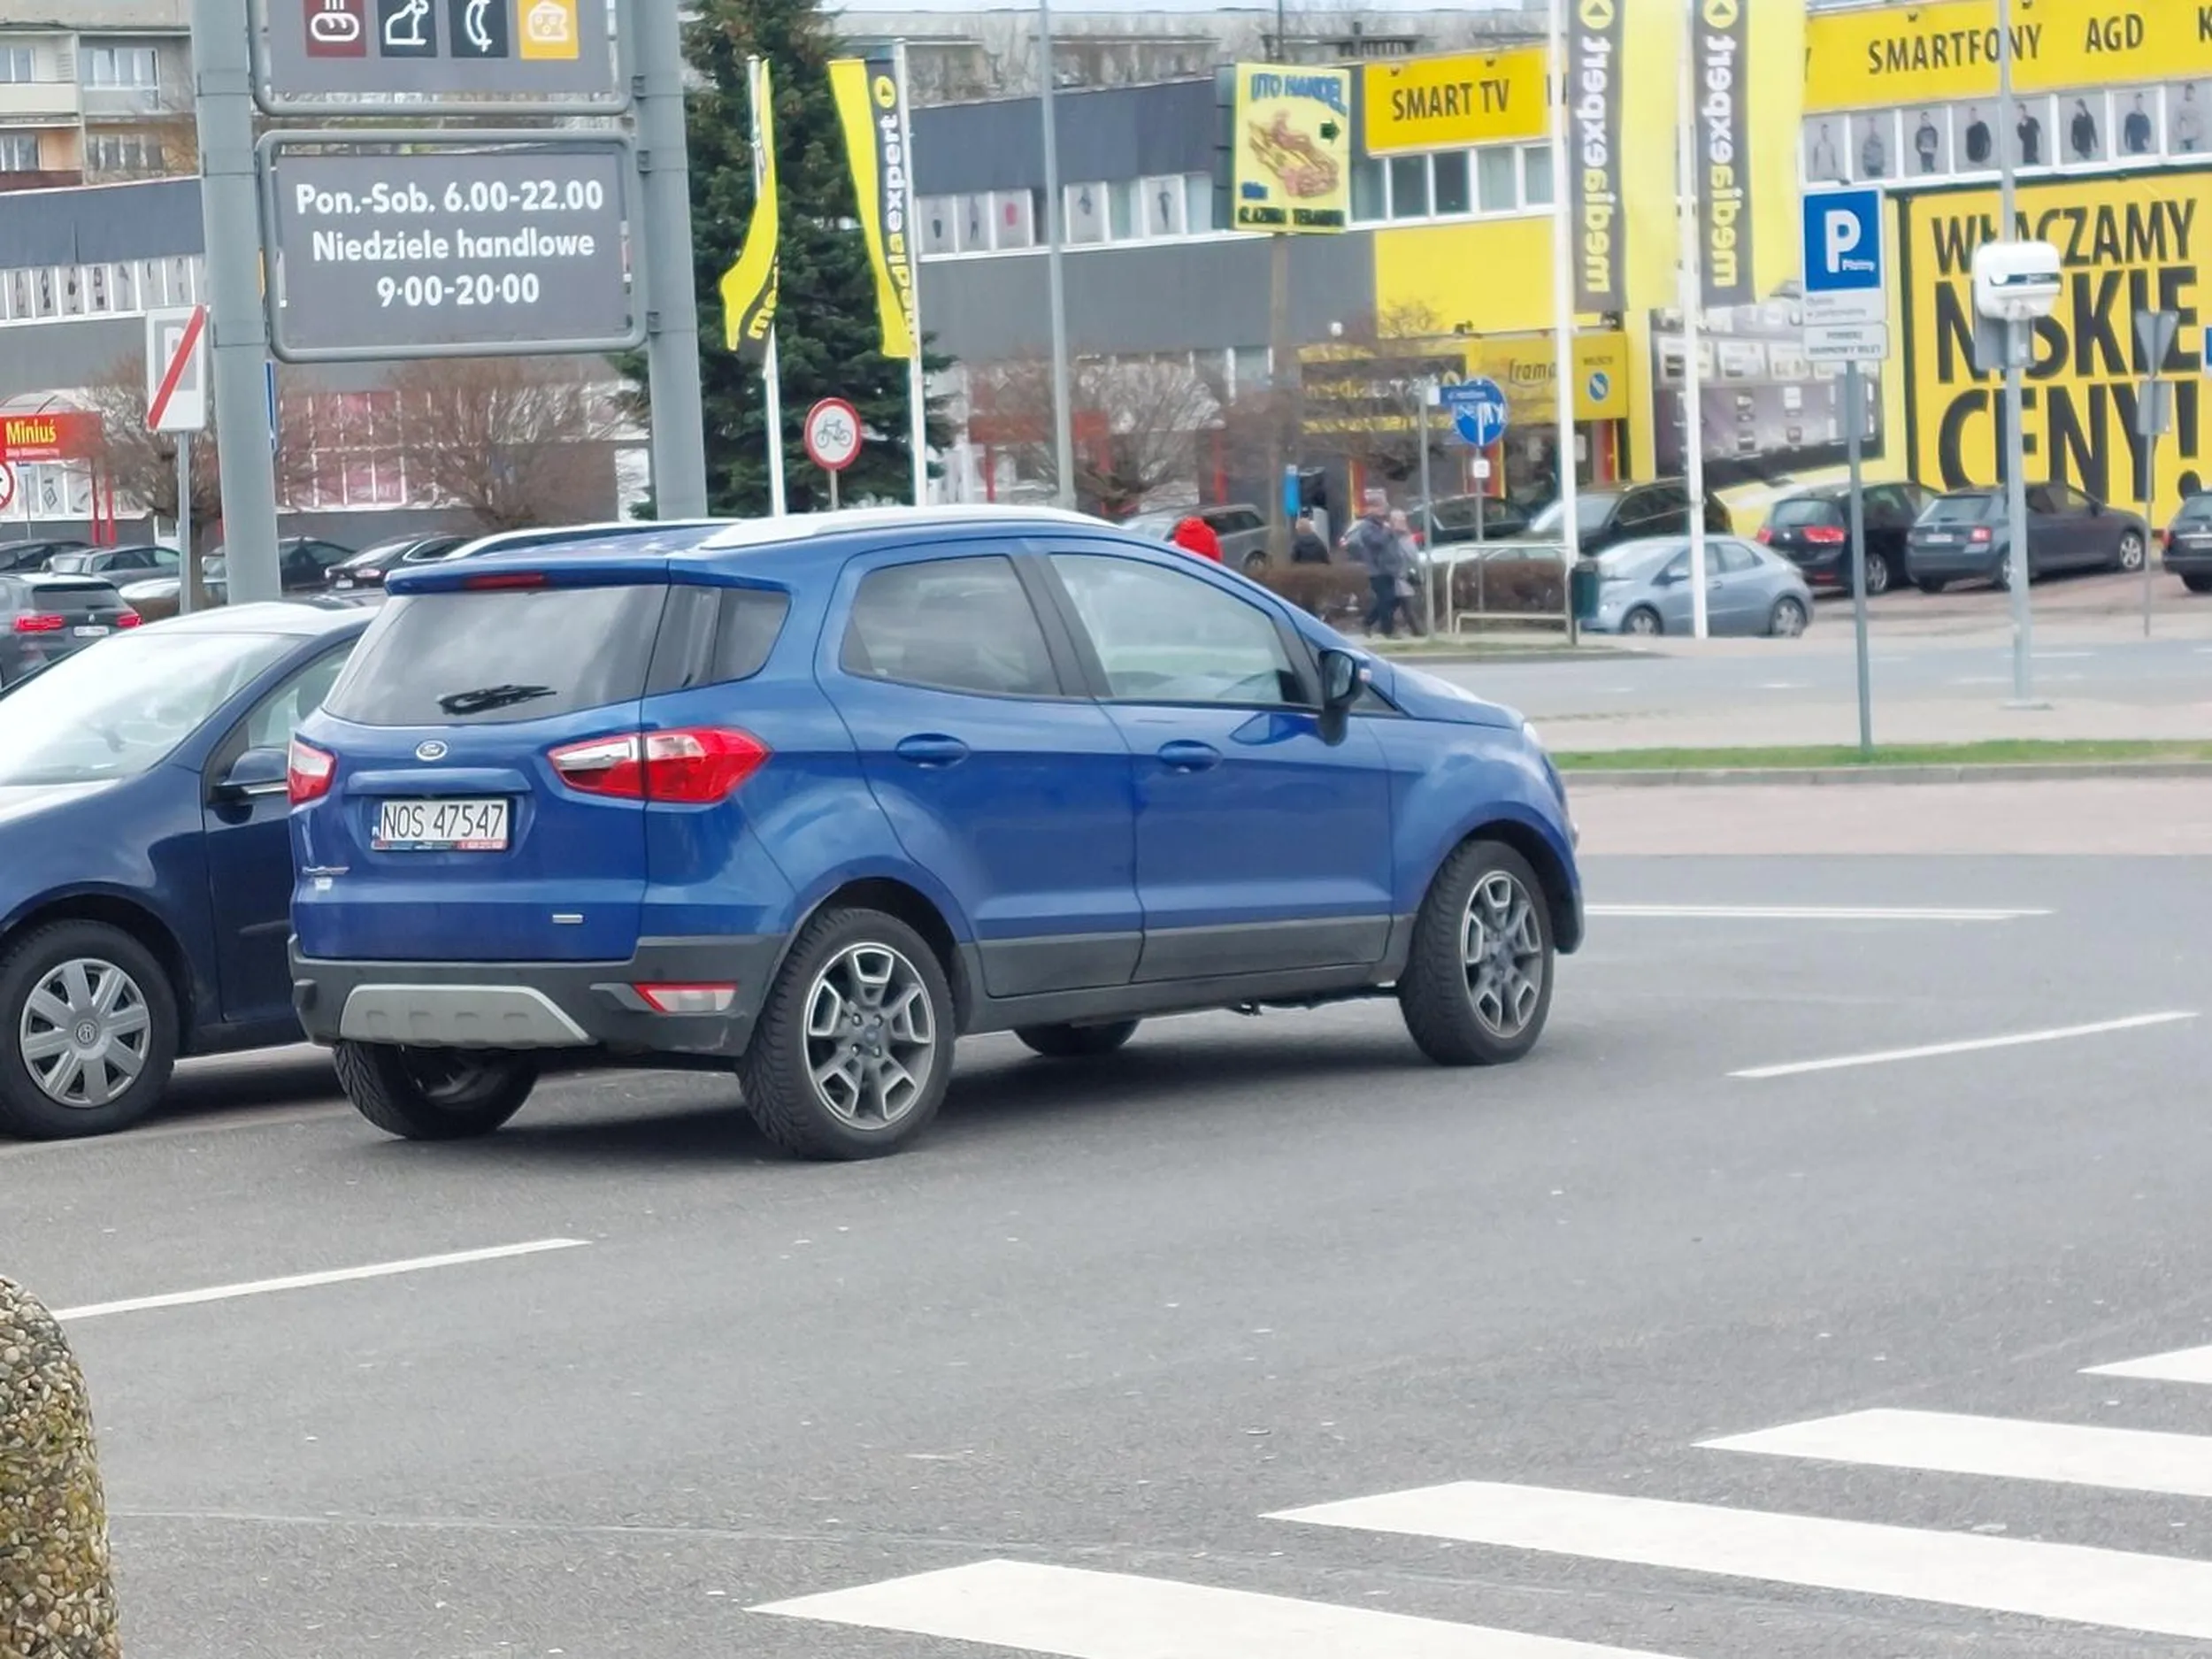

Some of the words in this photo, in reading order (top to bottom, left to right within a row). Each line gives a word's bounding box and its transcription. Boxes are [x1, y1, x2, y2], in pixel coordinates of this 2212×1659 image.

[1868, 23, 2042, 74] SMARTFONY
[2085, 12, 2144, 54] AGD
[1392, 81, 1473, 122] SMART
[1479, 78, 1510, 114] TV
[296, 180, 436, 214] Pon.-Sob.
[443, 179, 603, 212] 6.00-22.00
[312, 228, 449, 262] Niedziele
[457, 227, 595, 259] handlowe
[1824, 209, 1862, 274] P
[1934, 265, 2201, 385] NSKIE
[5, 418, 58, 446] Miniuś
[1937, 379, 2202, 505] CENY!
[382, 805, 426, 839] NOS
[434, 803, 504, 839] 47547
